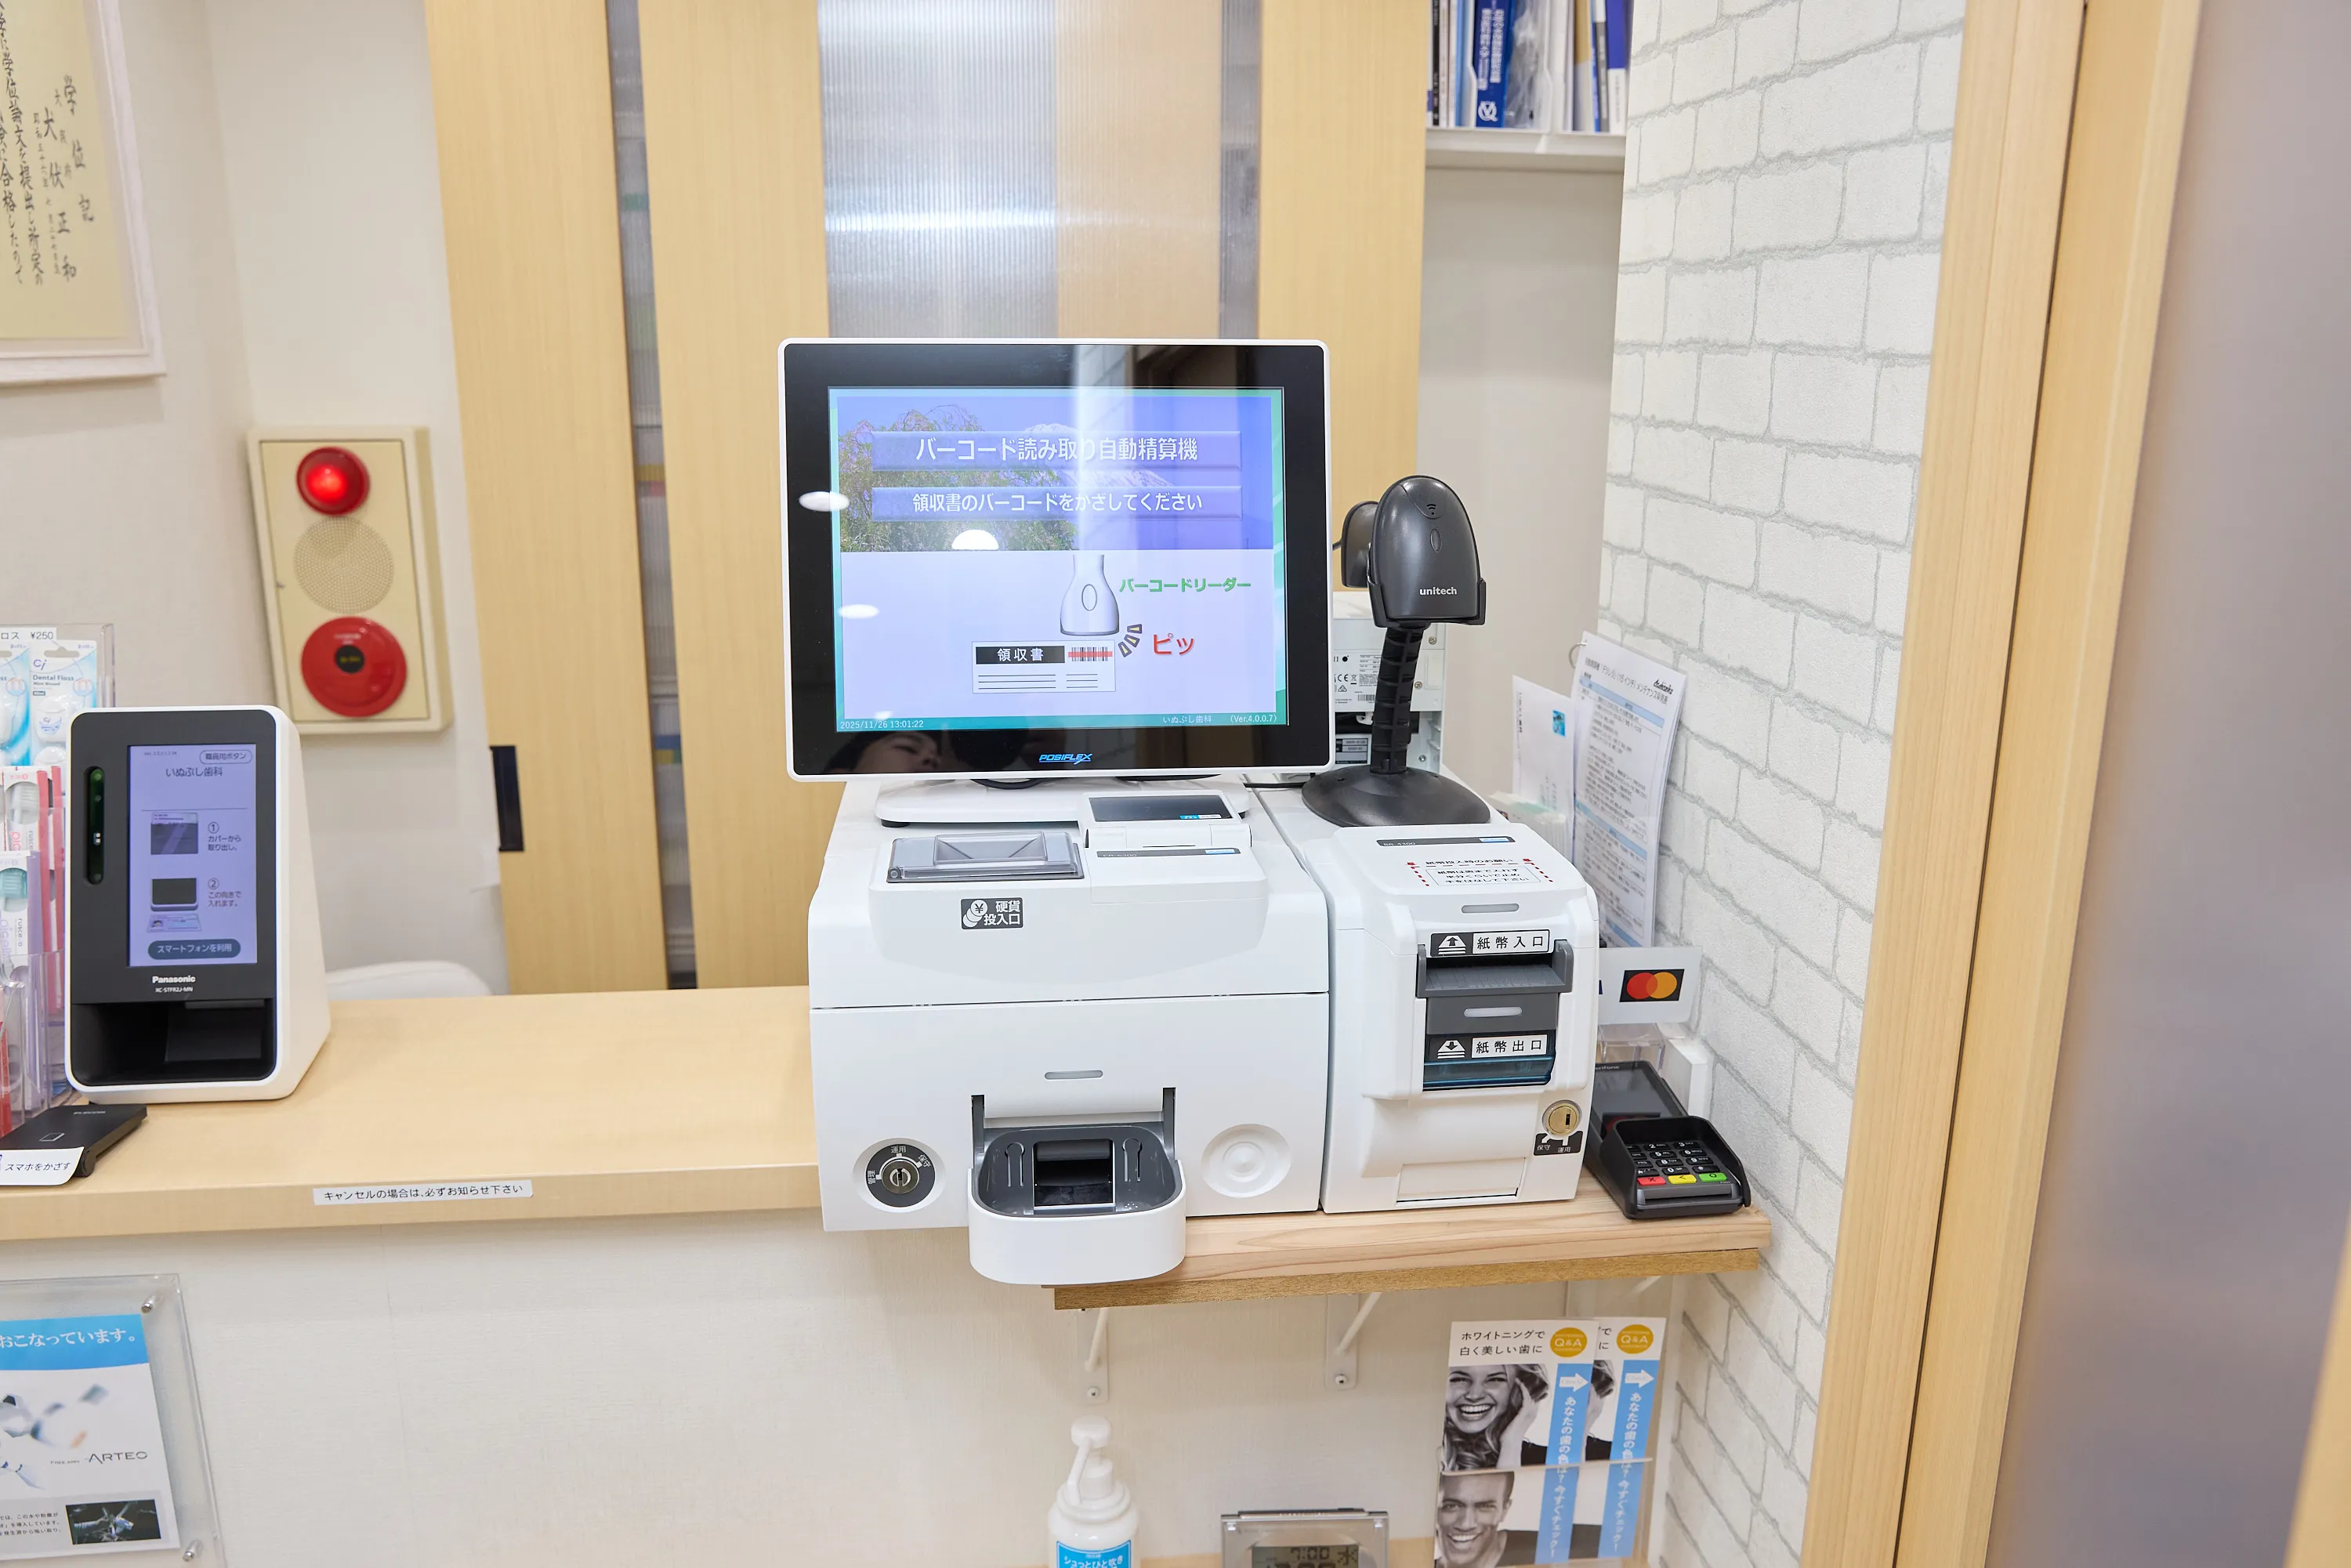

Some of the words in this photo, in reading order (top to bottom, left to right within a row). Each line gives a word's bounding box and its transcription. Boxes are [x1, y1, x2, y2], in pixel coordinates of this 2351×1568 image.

[915, 436, 1199, 462] バーコード読み取り自動精算機
[912, 492, 1204, 512] 領収書のバーコードをかざしてください
[1119, 578, 1252, 592] バーコードリーダー
[1419, 586, 1457, 596] unitech
[1153, 632, 1195, 656] ピッ
[997, 647, 1044, 662] 領収書
[840, 720, 888, 729] 2025/11/26
[889, 719, 924, 728] 13:01:22
[1163, 715, 1212, 724] いぬぶし歯科
[1039, 753, 1093, 765] POSIFLEX
[165, 767, 223, 777] いぬぶし歯科
[995, 900, 1020, 913] 硬貨
[984, 914, 1020, 925] 投入口
[158, 943, 232, 954] スマートフォンを利用
[1476, 936, 1544, 950] 紙幣入口
[152, 975, 196, 984] Panasonic
[1476, 1040, 1541, 1053] 紙幣出口
[5, 1163, 71, 1171] スマホをかざす
[324, 1185, 523, 1200] キャンセルの場合は、必ずお知らせ下さい
[0, 1327, 136, 1349] おこなっています。
[1461, 1330, 1545, 1341] ホワイトニングで
[1621, 1334, 1649, 1344] Q&A
[1555, 1338, 1582, 1347] Q&A
[1460, 1345, 1543, 1356] 白く美しい歯に
[89, 1451, 147, 1464] ARTEO
[1291, 1547, 1330, 1560] 7:00
